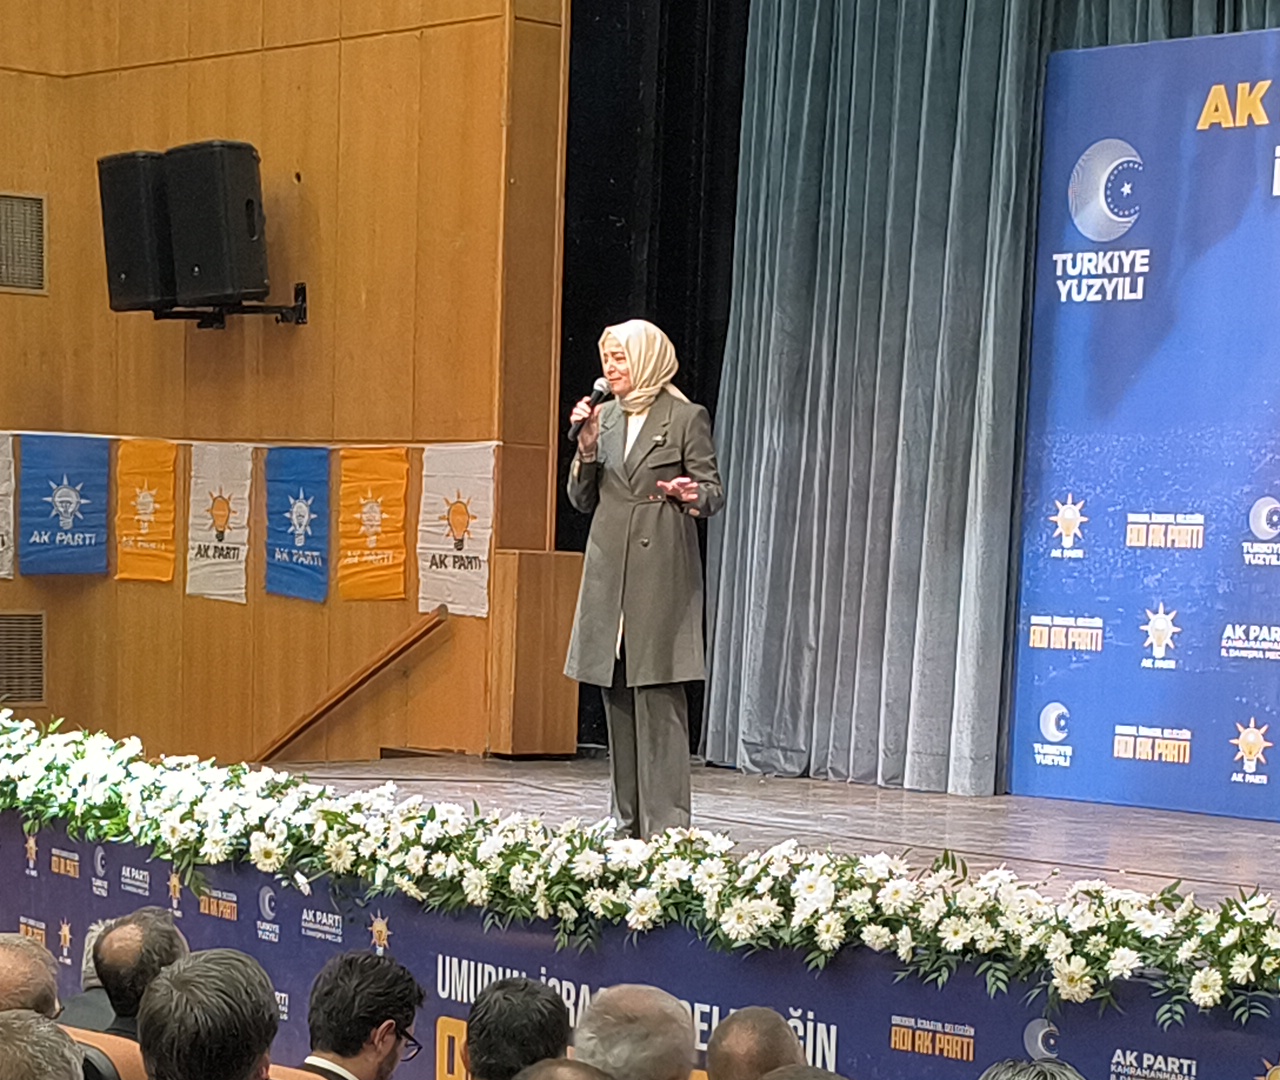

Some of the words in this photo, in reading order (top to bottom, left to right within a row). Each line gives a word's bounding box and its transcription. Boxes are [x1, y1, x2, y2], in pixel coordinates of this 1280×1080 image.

[1195, 79, 1273, 131] AK
[29, 531, 50, 545] AK
[195, 545, 211, 559] AK
[429, 554, 448, 569] AK
[1222, 624, 1247, 641] AK
[302, 908, 315, 921] AK
[1112, 1049, 1139, 1068] AK
